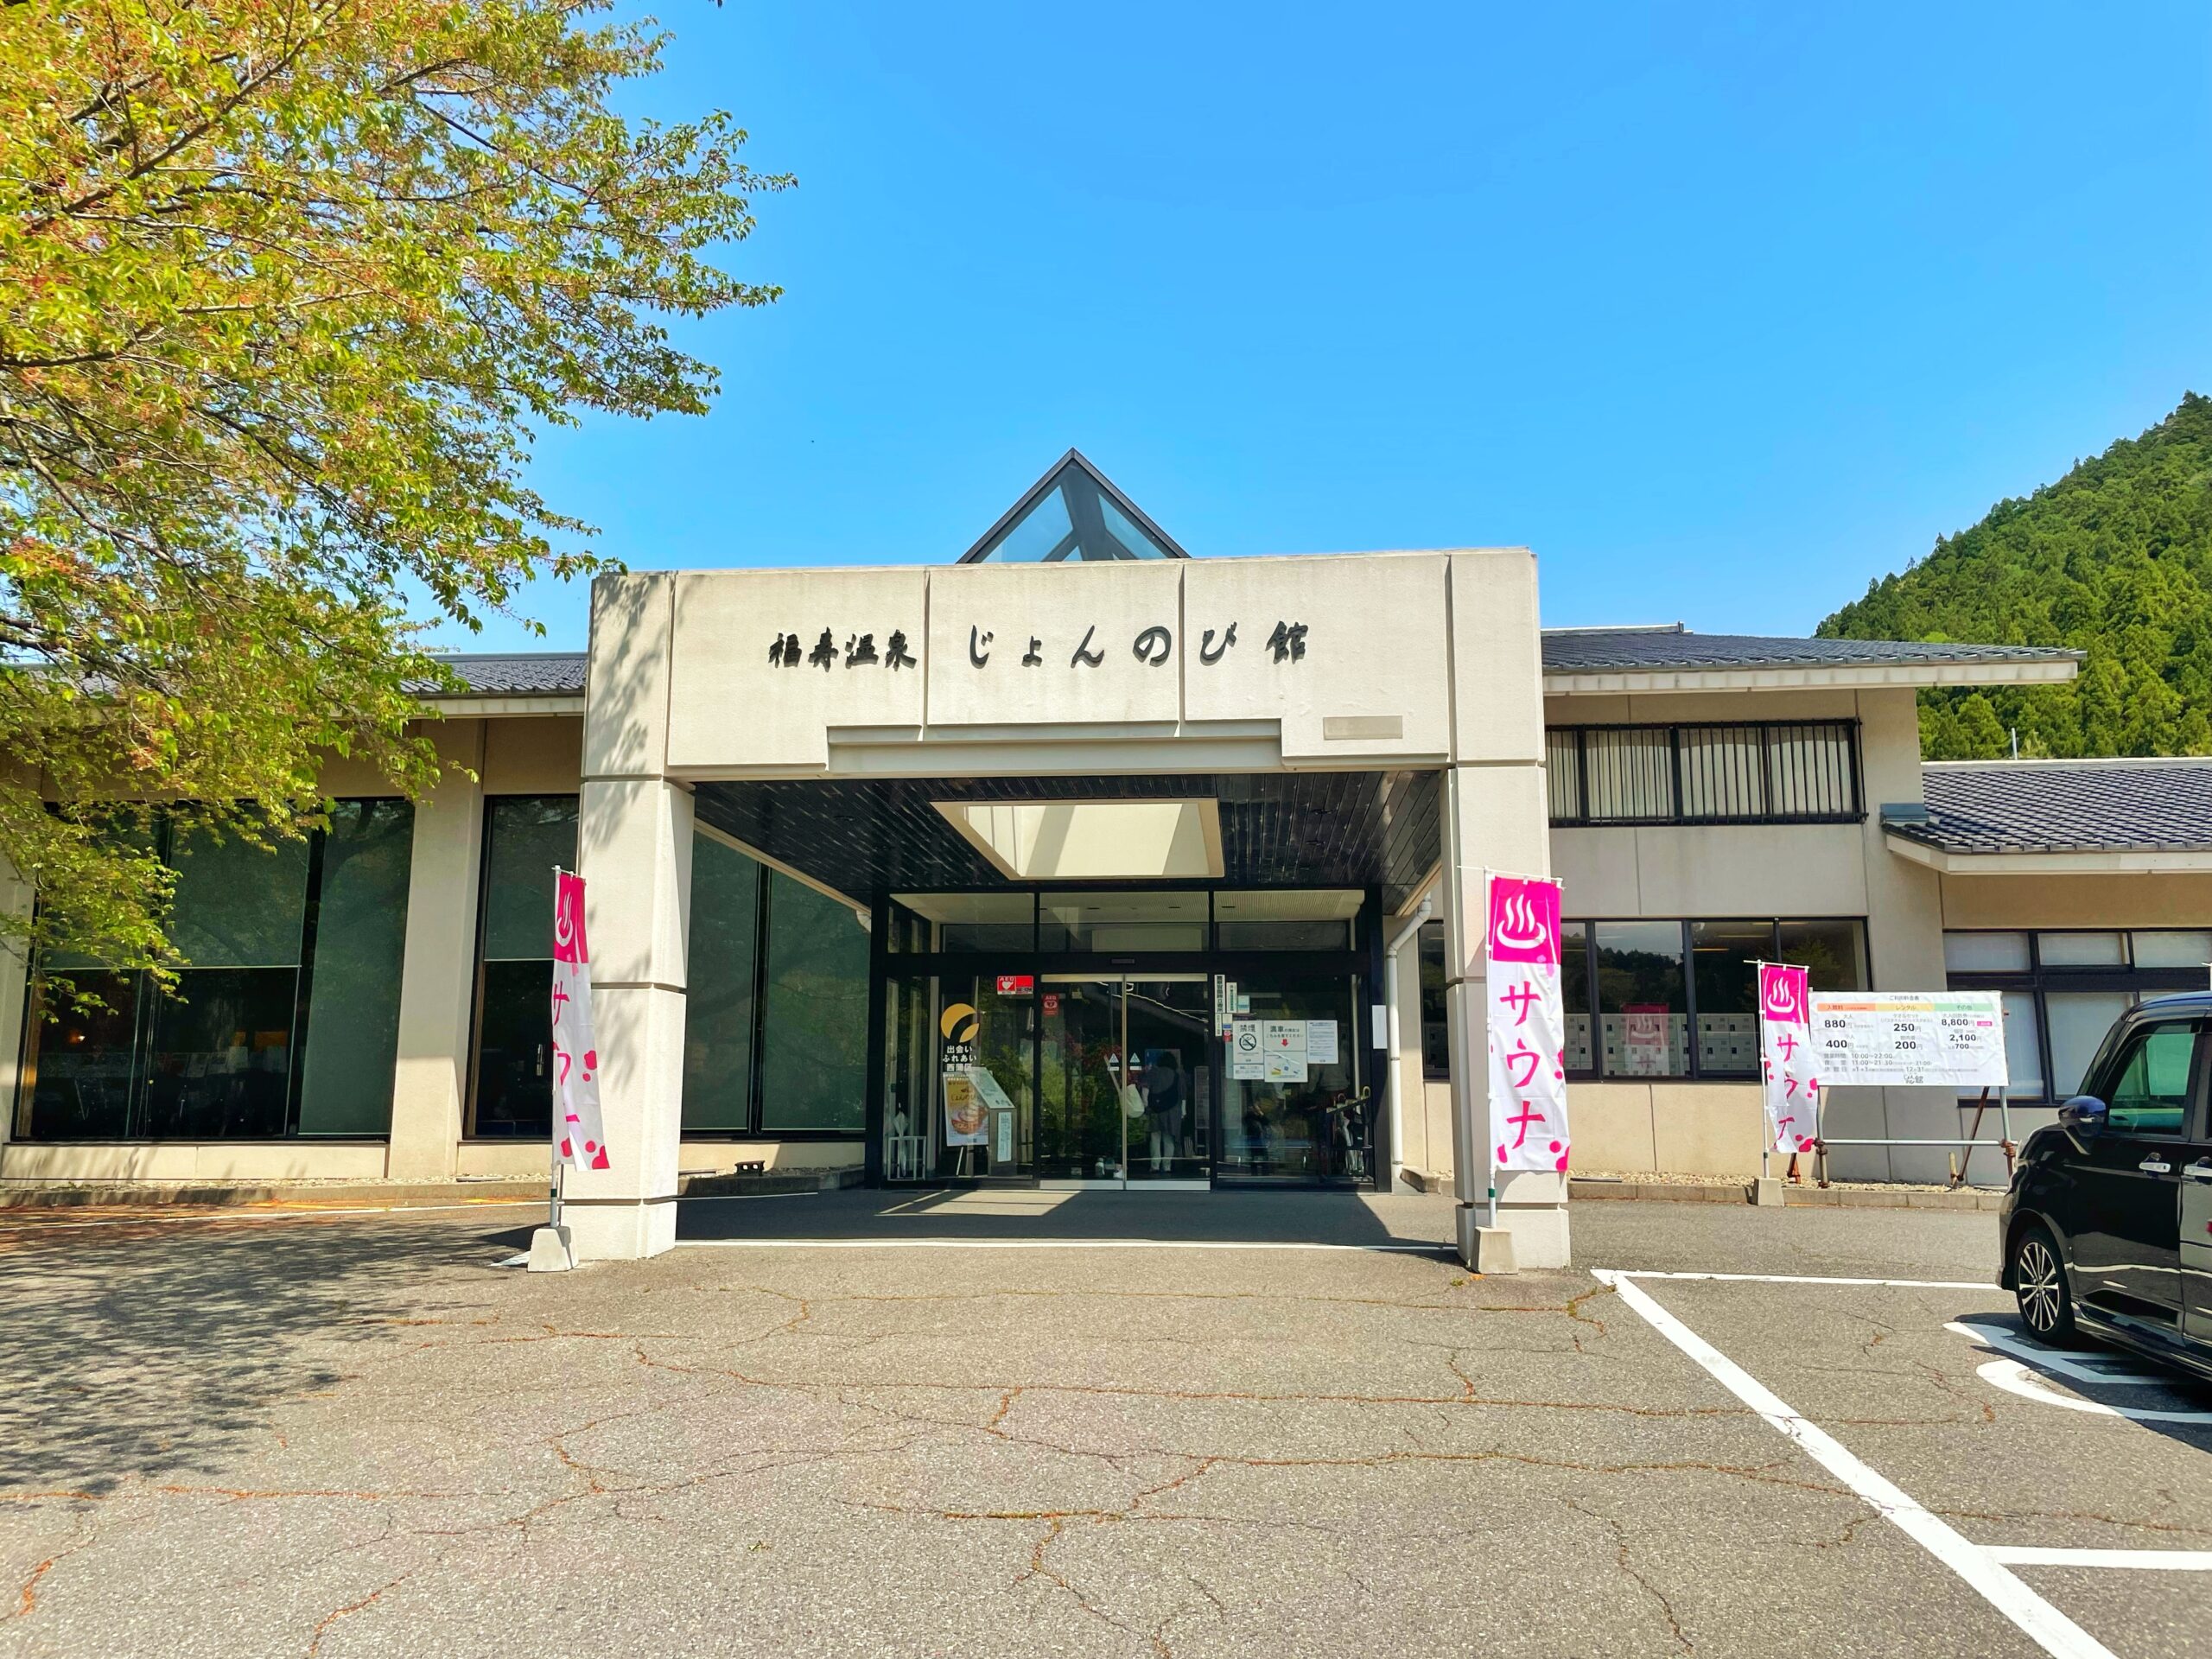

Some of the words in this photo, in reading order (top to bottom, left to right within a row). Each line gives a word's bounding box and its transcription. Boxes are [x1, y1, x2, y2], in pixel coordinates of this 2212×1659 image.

[768, 627, 917, 670] 福寿温泉
[969, 620, 1308, 669] じょんのび館
[1824, 1020, 1853, 1028] 880円
[1893, 1023, 1921, 1032] 250円
[1942, 1019, 1974, 1027] 8,800円
[1826, 1039, 1854, 1049] 400円
[1895, 1041, 1923, 1050] 200円
[1500, 981, 1545, 1150] サウナ
